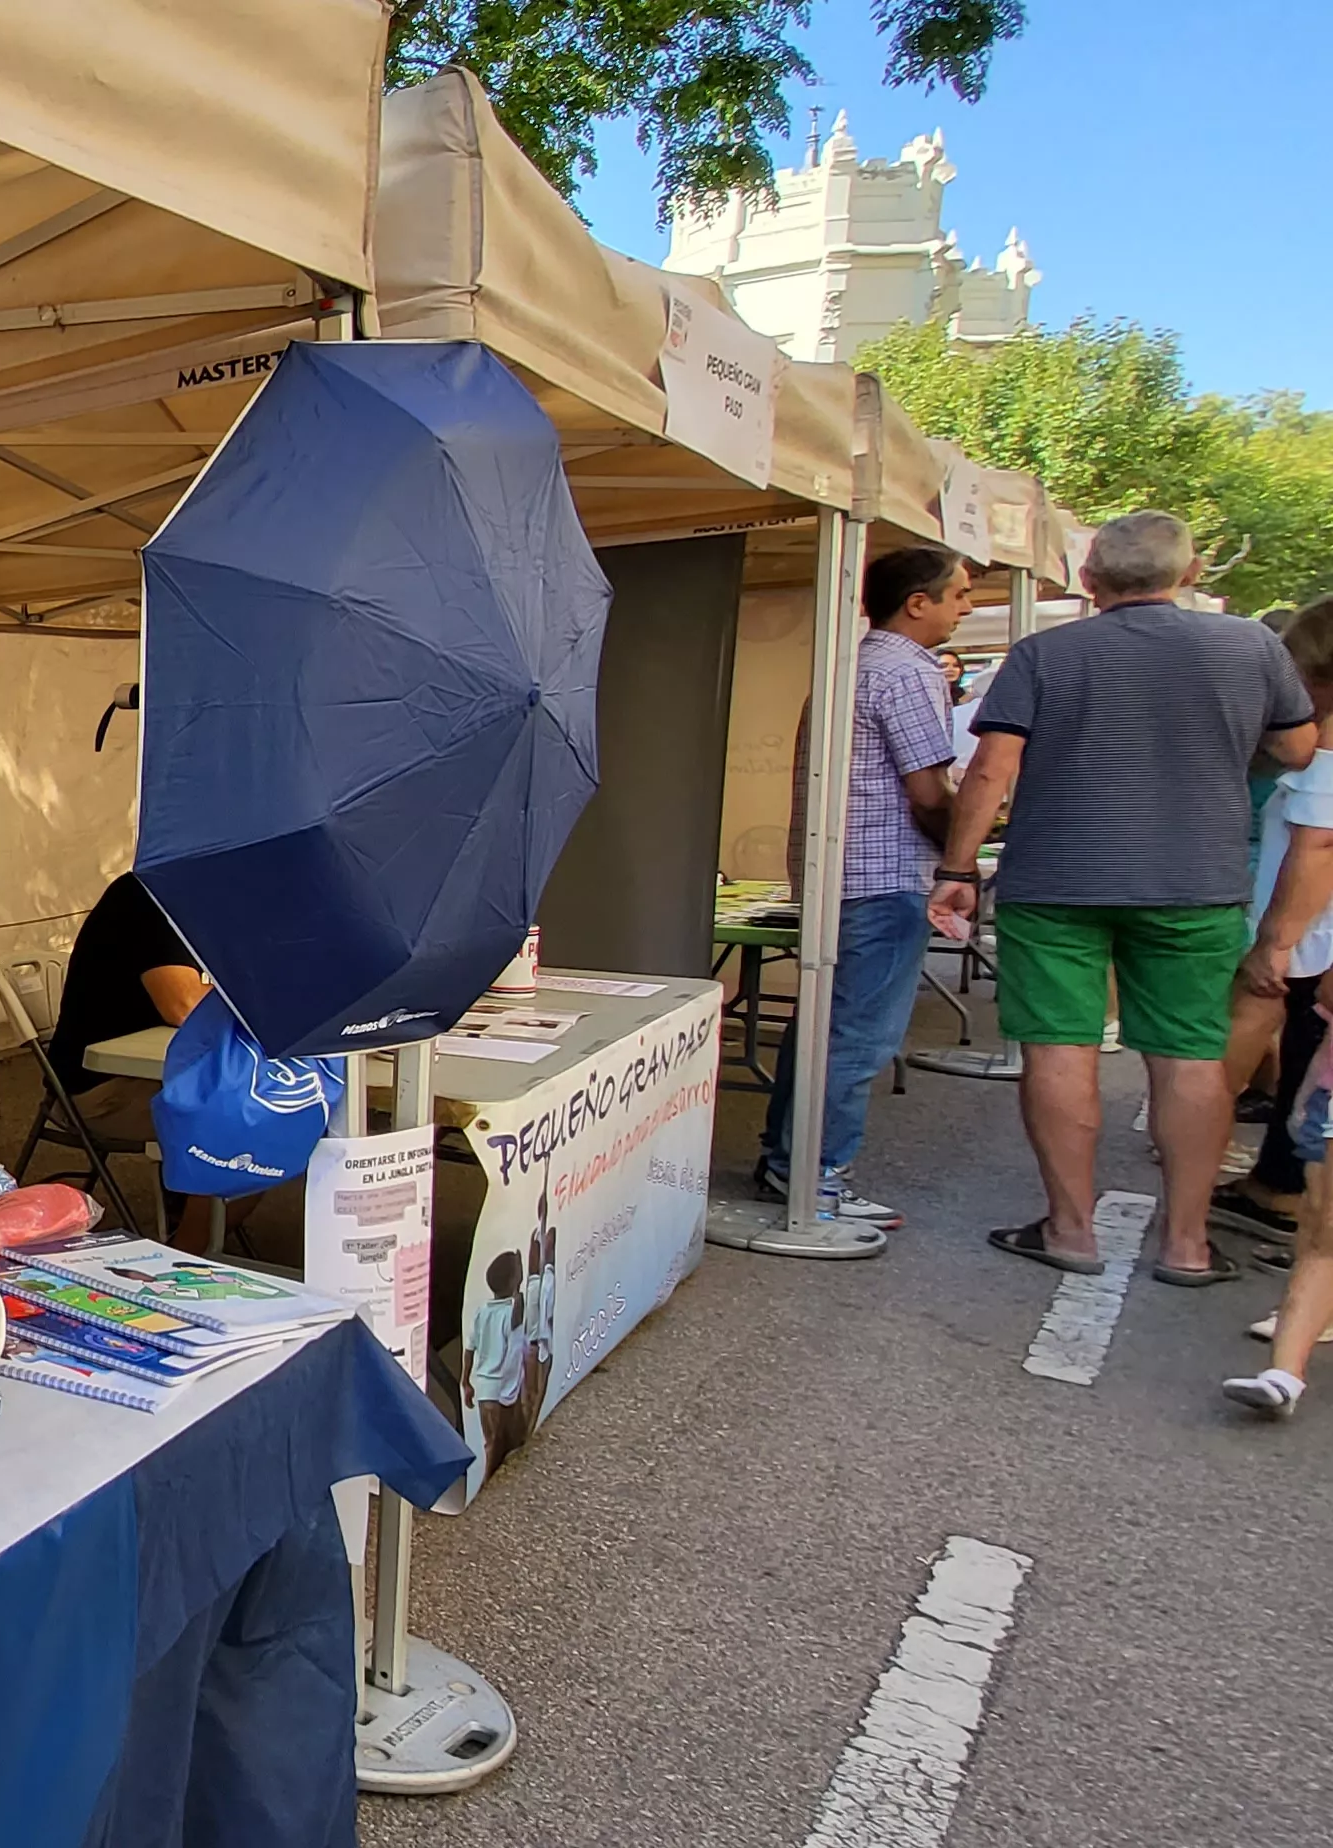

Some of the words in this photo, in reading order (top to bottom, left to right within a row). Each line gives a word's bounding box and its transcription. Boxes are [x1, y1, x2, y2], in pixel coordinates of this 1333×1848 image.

[177, 350, 284, 388] MASTERT
[706, 354, 743, 386] PEQUEÑO
[744, 372, 762, 395] GRAN
[724, 396, 743, 419] PASO
[487, 1070, 615, 1187] PEQUEÑO
[620, 1039, 675, 1112] GRAN
[674, 1013, 716, 1066] PAS
[188, 1145, 229, 1168] Manos
[247, 1162, 285, 1178] Unidas
[345, 1153, 396, 1170] ORIENTARSE
[362, 1173, 374, 1184] EN
[376, 1171, 386, 1182] LA
